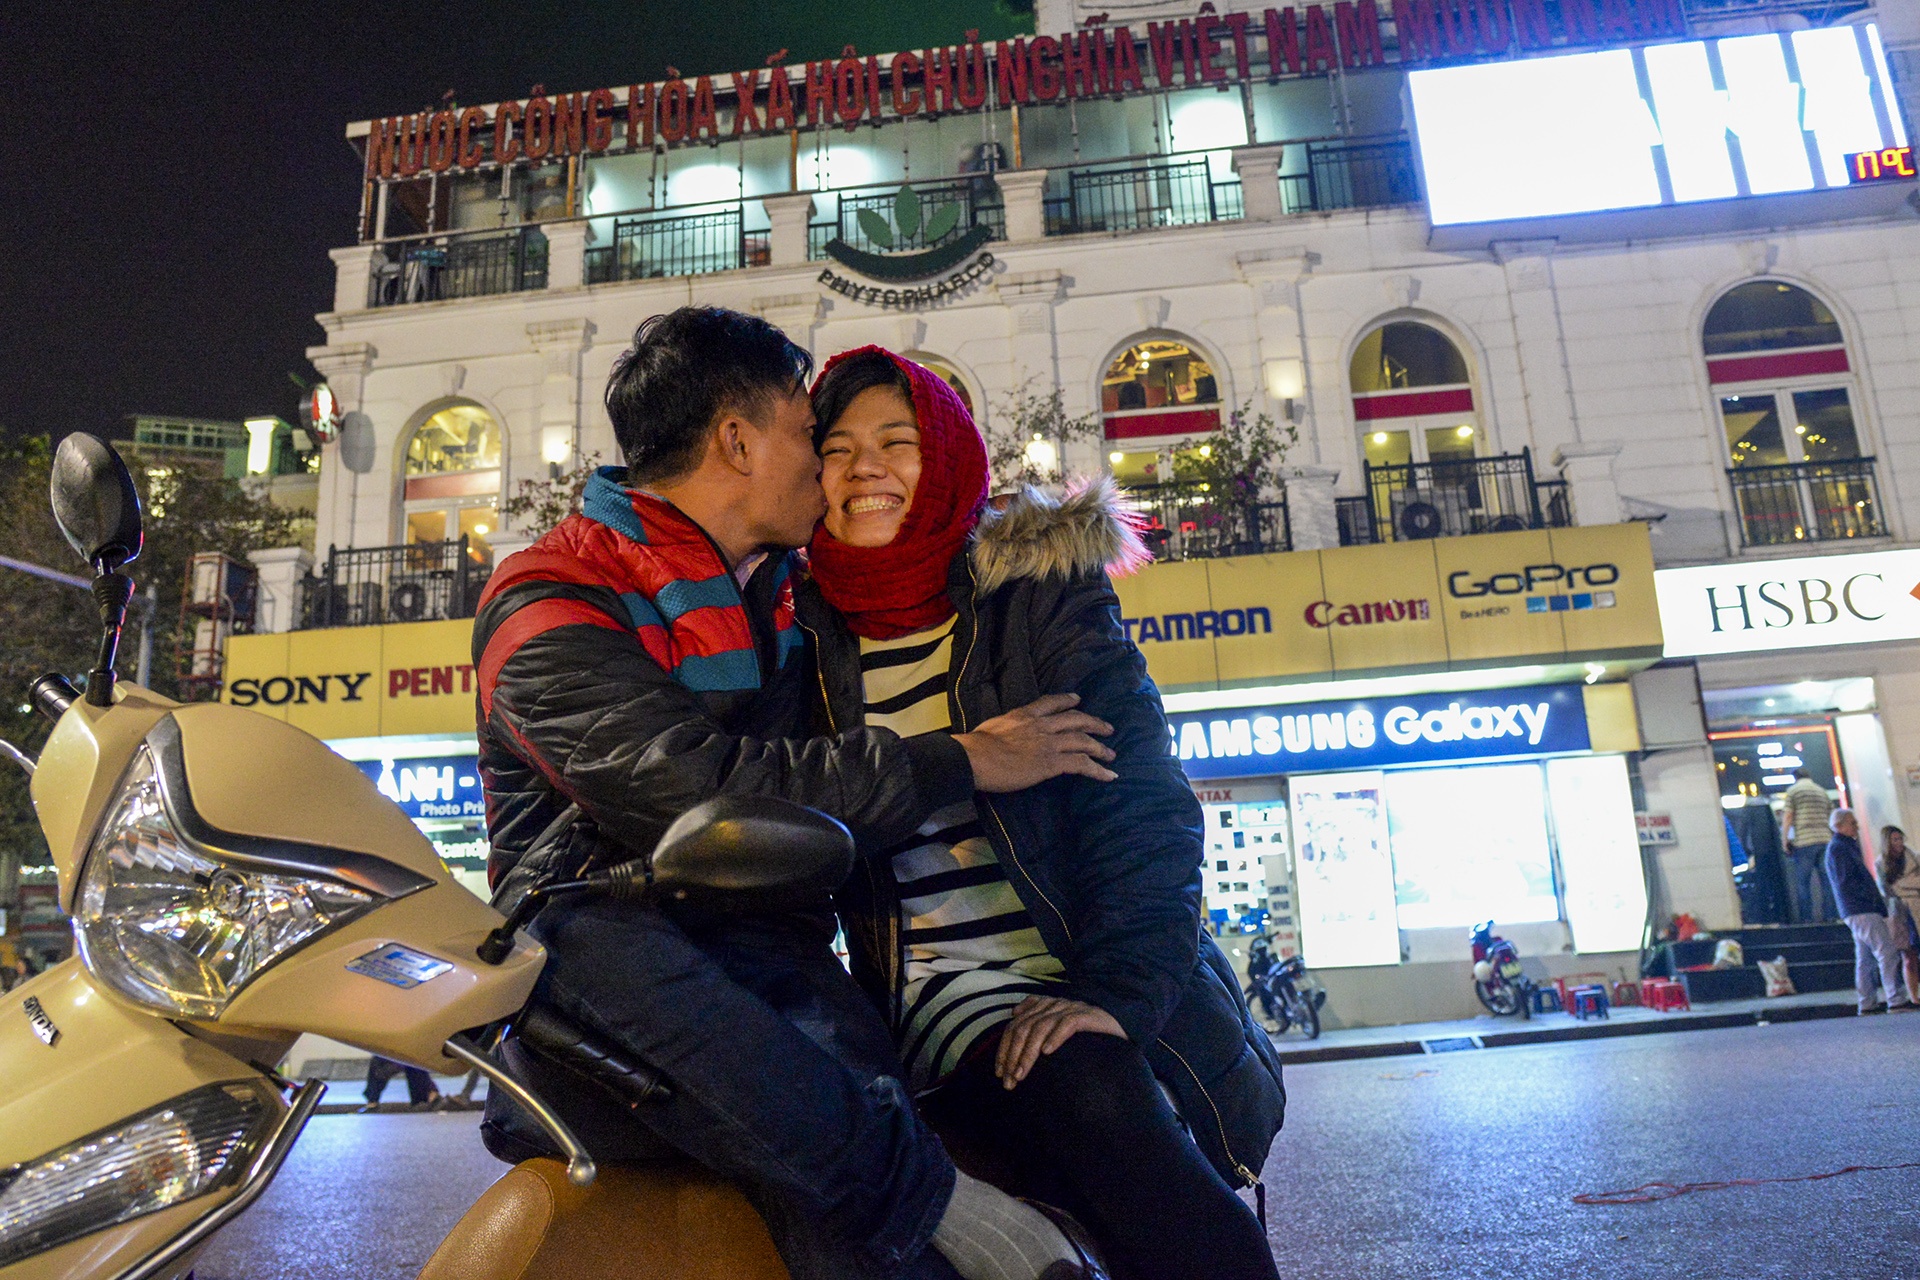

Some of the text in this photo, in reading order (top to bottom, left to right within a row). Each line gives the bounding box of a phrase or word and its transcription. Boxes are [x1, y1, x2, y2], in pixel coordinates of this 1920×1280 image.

[493, 84, 613, 170] CỘNG
[626, 66, 718, 148] HÒA
[805, 44, 881, 132] HỘI
[891, 28, 986, 115] CHỦ
[996, 12, 1145, 106] NGHĨA
[1147, 2, 1250, 92] VIỆT
[1264, 0, 1386, 74] NAM
[817, 251, 995, 307] PHYTOPHARCO
[1447, 563, 1620, 599] GoPro
[1303, 598, 1430, 629] Canon
[1705, 573, 1887, 633] HSBC
[1121, 606, 1272, 645] TAMRON
[230, 673, 371, 707] SONY
[388, 664, 478, 698] PENT
[1383, 702, 1550, 746] Galaxy
[420, 800, 485, 817] Photo Pri
